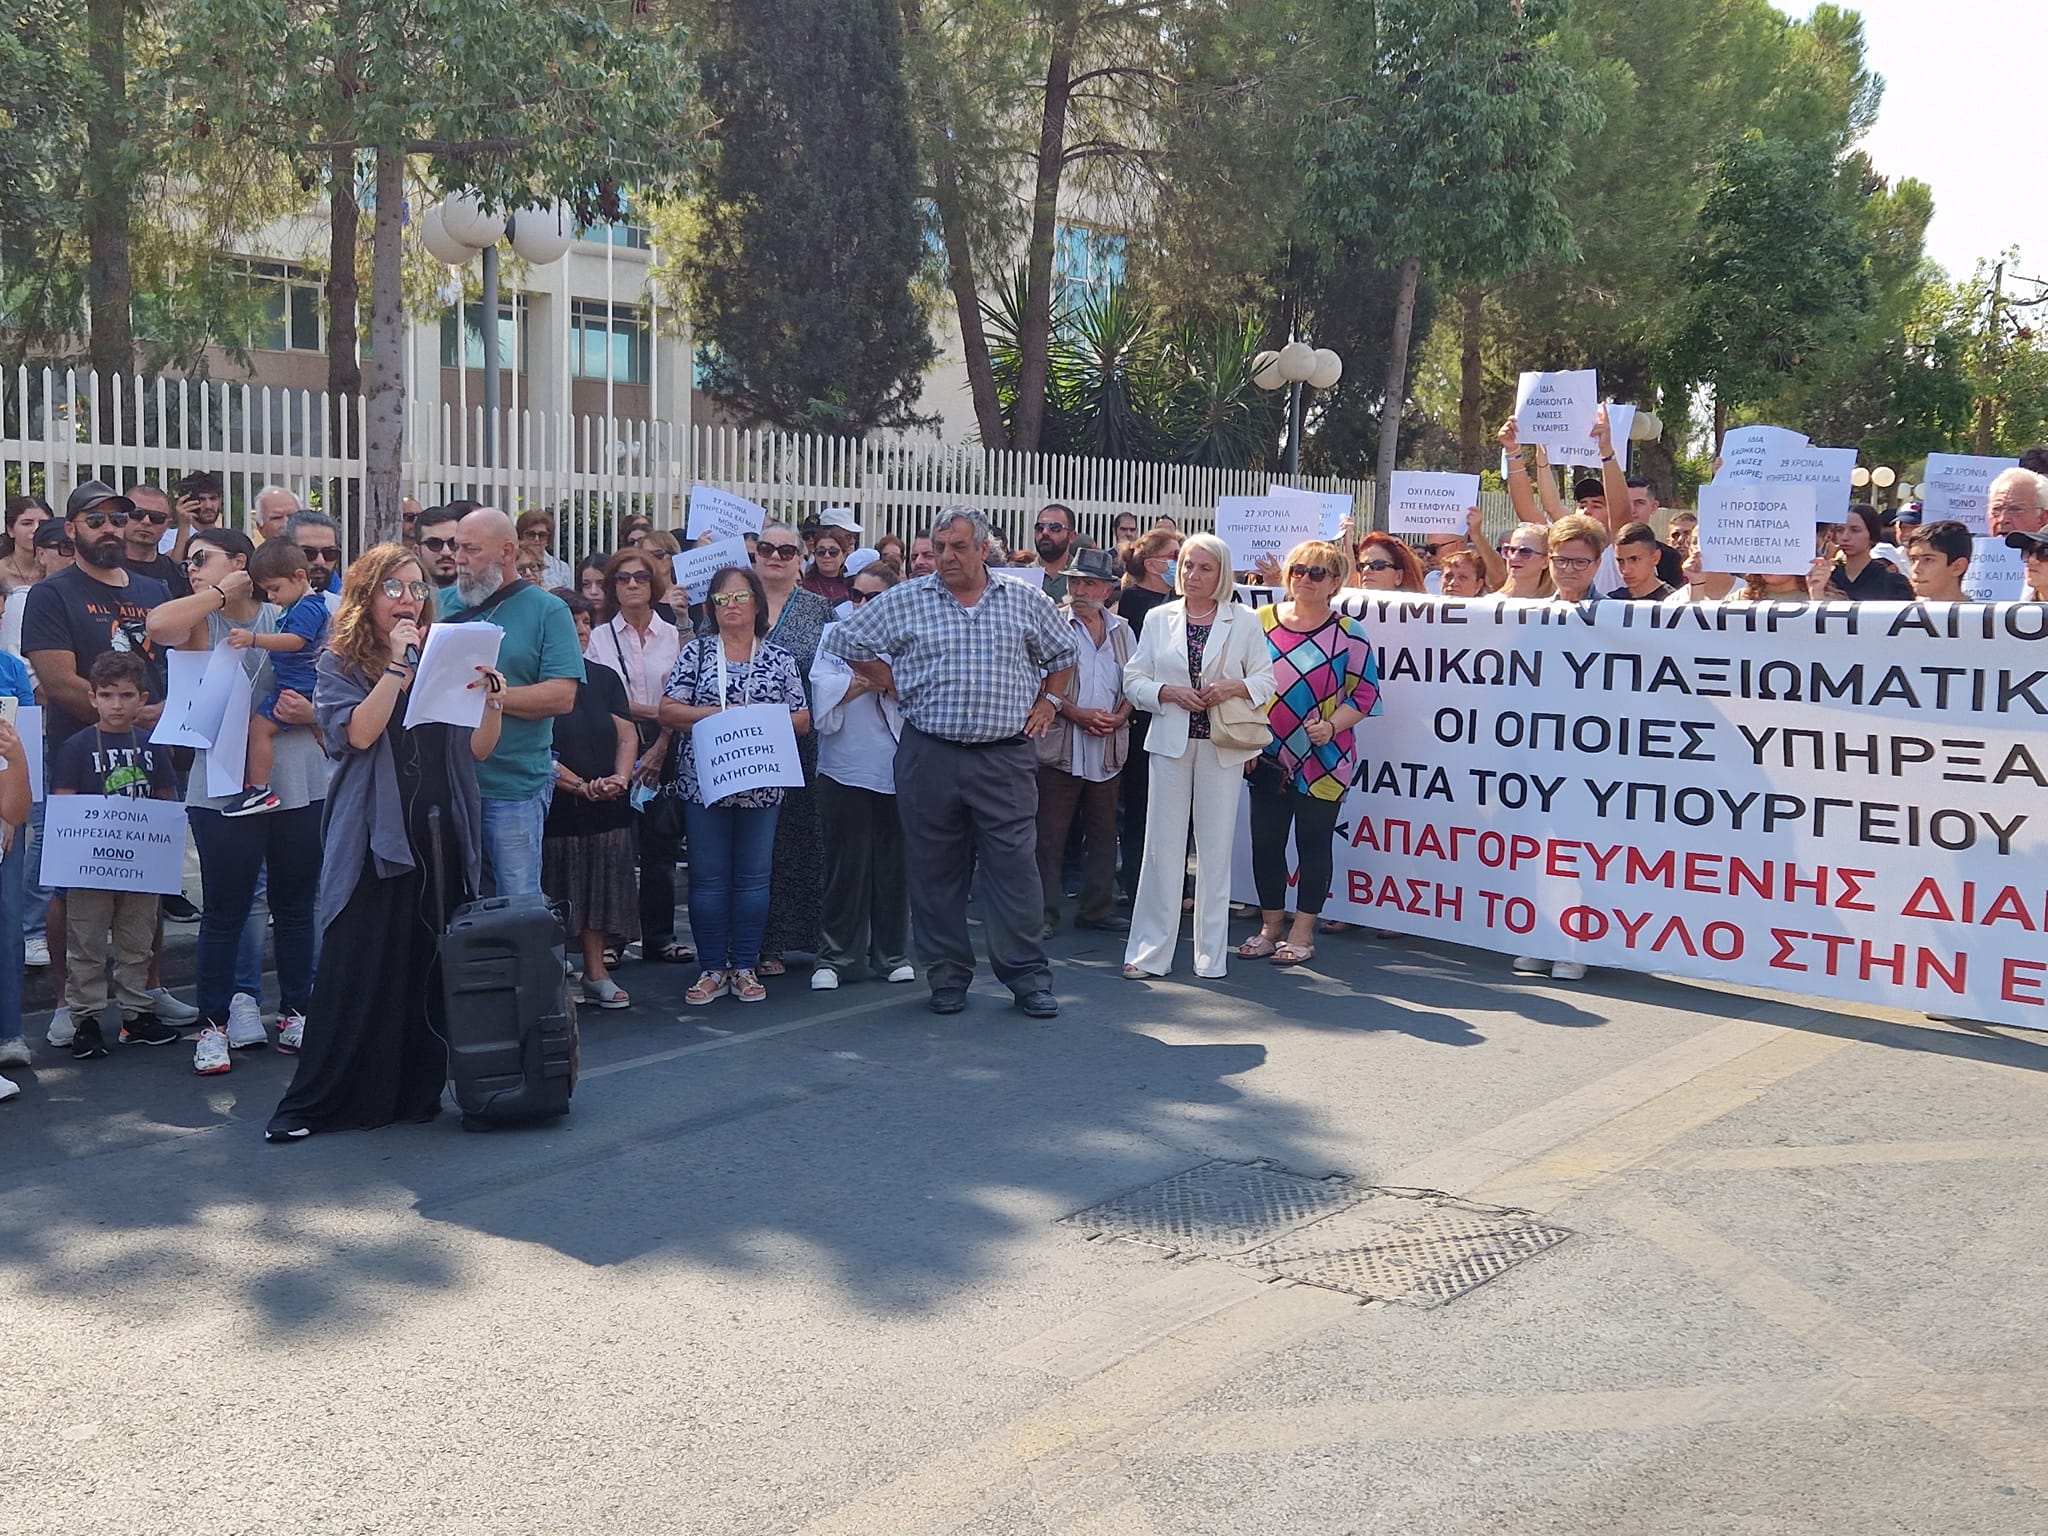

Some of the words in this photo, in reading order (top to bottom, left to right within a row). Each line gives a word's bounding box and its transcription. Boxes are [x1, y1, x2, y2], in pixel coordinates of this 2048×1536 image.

[1539, 384, 1555, 394] ΙΔΙΑ
[1526, 397, 1574, 407] ΚΑΘΗΚΟΝΤΑ
[1536, 410, 1563, 420] ΑΝΙΣΕΣ
[1532, 423, 1569, 433] ΕΥΚΑΙΡΙΕΣ
[1805, 474, 1820, 482] ΚΑΙ
[1822, 474, 1841, 483] ΜΙΑ
[1407, 487, 1423, 496] ΟΧΙ
[1424, 488, 1456, 497] ΠΛΕΟΝ
[1399, 501, 1416, 510] ΣΤΙΣ
[1418, 502, 1461, 512] ΕΜΦΥΛΕΣ
[1720, 501, 1728, 510] Η
[1730, 501, 1788, 512] ΠΡΟΣΦΟΡΑ
[1244, 510, 1255, 518] 27
[1256, 510, 1290, 518] ΧΡΟΝΙΑ
[1404, 515, 1457, 524] ΑΝΙΣΟΤΗΤΕΣ
[1226, 524, 1273, 533] ΥΠΗΡΕΣΙΑΣ
[1274, 525, 1288, 533] ΚΑΙ
[1290, 525, 1309, 533] ΜΙΑ
[1717, 518, 1744, 529] ΣΤΗΝ
[1746, 519, 1790, 529] ΠΑΤΡΙΔΑ
[1251, 539, 1281, 548] ΜΟΝΟ
[1706, 536, 1781, 547] ΑΝΤΑΜΕΙΒΕΤΑΙ
[1783, 538, 1801, 548] ΜΕ
[1725, 554, 1746, 563] ΤΗΝ
[1748, 554, 1782, 565] ΑΔΙΚΙΑ
[1985, 571, 2003, 581] ΚΑΙ
[1887, 601, 2048, 641] ΑΠΟ
[1563, 651, 2048, 715] ΥΠΑΞΙΩΜΑΤΙΚ
[714, 726, 765, 747] ΠΟΛΙΤΕΣ
[1434, 707, 1478, 745] ΟΙ
[1495, 711, 1716, 762] ΟΠΟΙΕΣ
[1737, 724, 2048, 787] ΥΠΗΡΞΑ
[710, 744, 776, 768] ΚΑΤΩΤΕΡΗΣ
[712, 762, 781, 787] ΚΑΤΗΓΟΡΙΑΣ
[84, 809, 100, 819] 29
[103, 810, 149, 823] ΧΡΟΝΙΑ
[1469, 768, 1567, 813] ΤΟΥ
[1584, 778, 2029, 856] ΥΠΟΥΡΓΕΙΟΥ
[56, 827, 122, 840] ΥΠΗΡΕΣΙΑΣ
[125, 831, 145, 841] ΚΑΙ
[147, 832, 171, 844] ΜΙΑ
[92, 846, 135, 860] ΜΟΝΟ
[79, 865, 144, 880] ΠΡΟΑΓΩΓΗ
[1900, 876, 2048, 933] ΔΙΑ
[1348, 869, 1463, 922] ΒΑΣΗ
[1479, 890, 1536, 935] ΤΟ
[1559, 904, 1745, 961] ΦΥΛΟ
[1769, 927, 1968, 995] ΣΤΗΝ
[2001, 957, 2048, 1006] Ε
